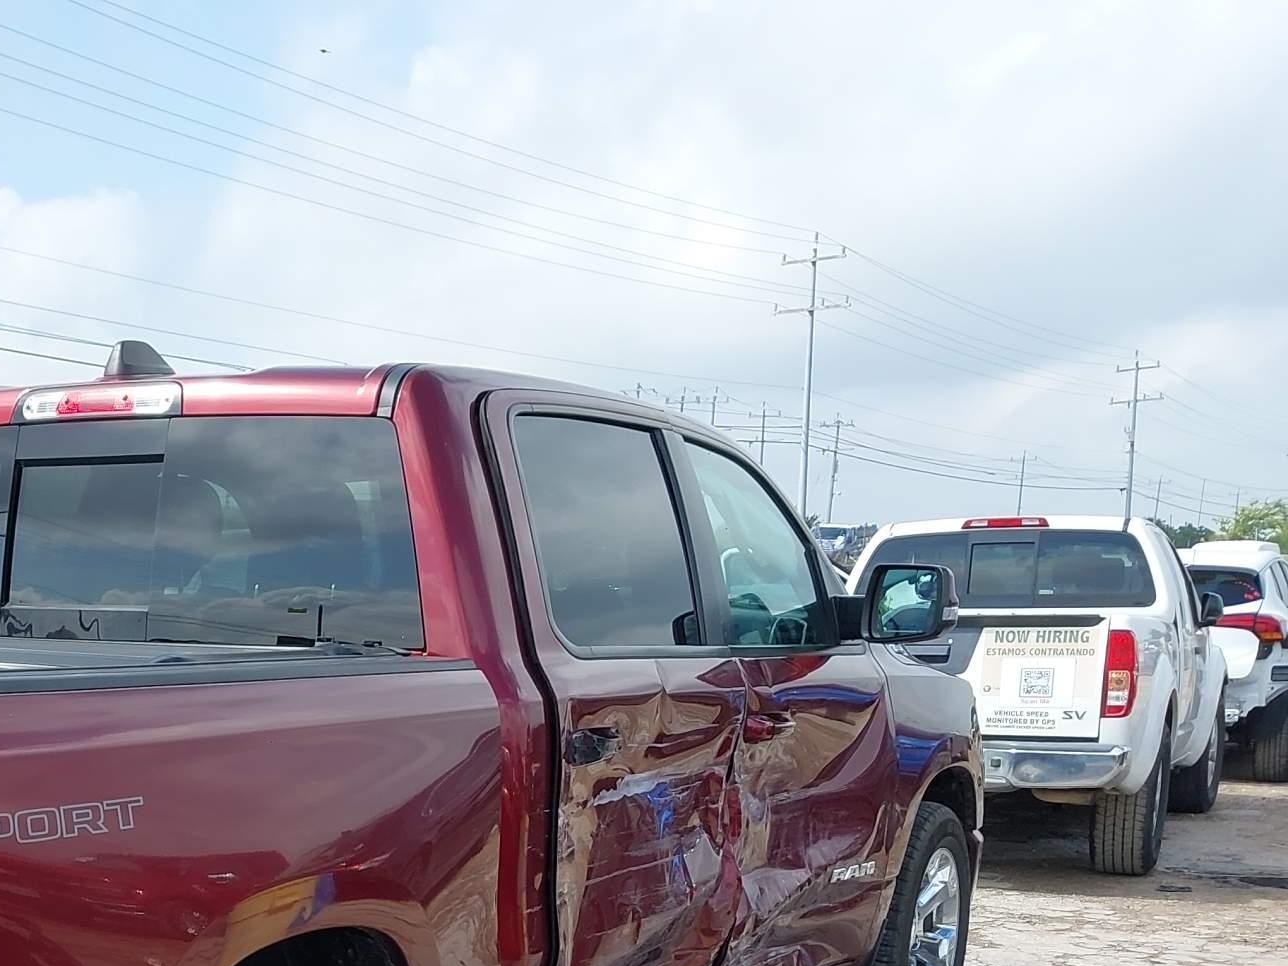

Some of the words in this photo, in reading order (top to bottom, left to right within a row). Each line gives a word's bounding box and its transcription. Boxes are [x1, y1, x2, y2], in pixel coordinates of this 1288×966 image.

[994, 630, 1030, 643] NOW
[1035, 630, 1090, 643] HIRING
[986, 648, 1026, 656] ESTAMOS
[1029, 648, 1095, 656] CONTRATANDO
[1062, 710, 1087, 720] SV
[986, 717, 1028, 725] MONITORED
[830, 860, 876, 884] RAM
